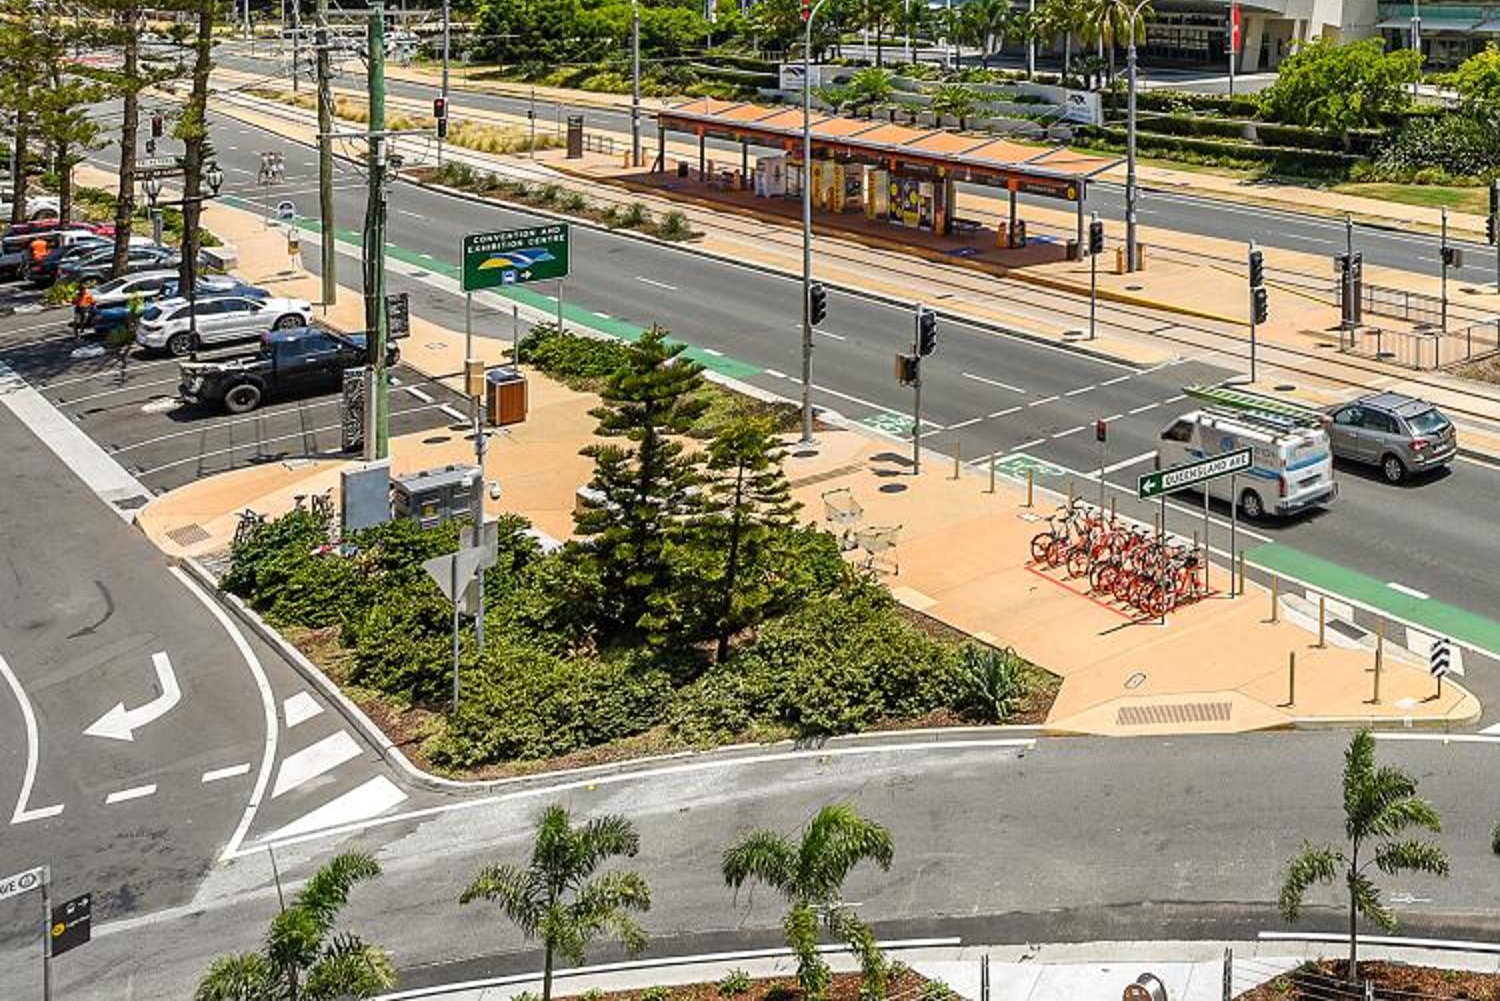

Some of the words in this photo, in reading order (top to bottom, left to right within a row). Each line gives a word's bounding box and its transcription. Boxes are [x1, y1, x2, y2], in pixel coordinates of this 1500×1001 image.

[467, 239, 523, 254] EXHIBITION
[527, 234, 565, 246] CENTRE
[473, 229, 537, 244] CONVENTION
[541, 226, 561, 236] AND
[1165, 460, 1227, 486] QUEENSLAND
[1229, 454, 1246, 467] AVE
